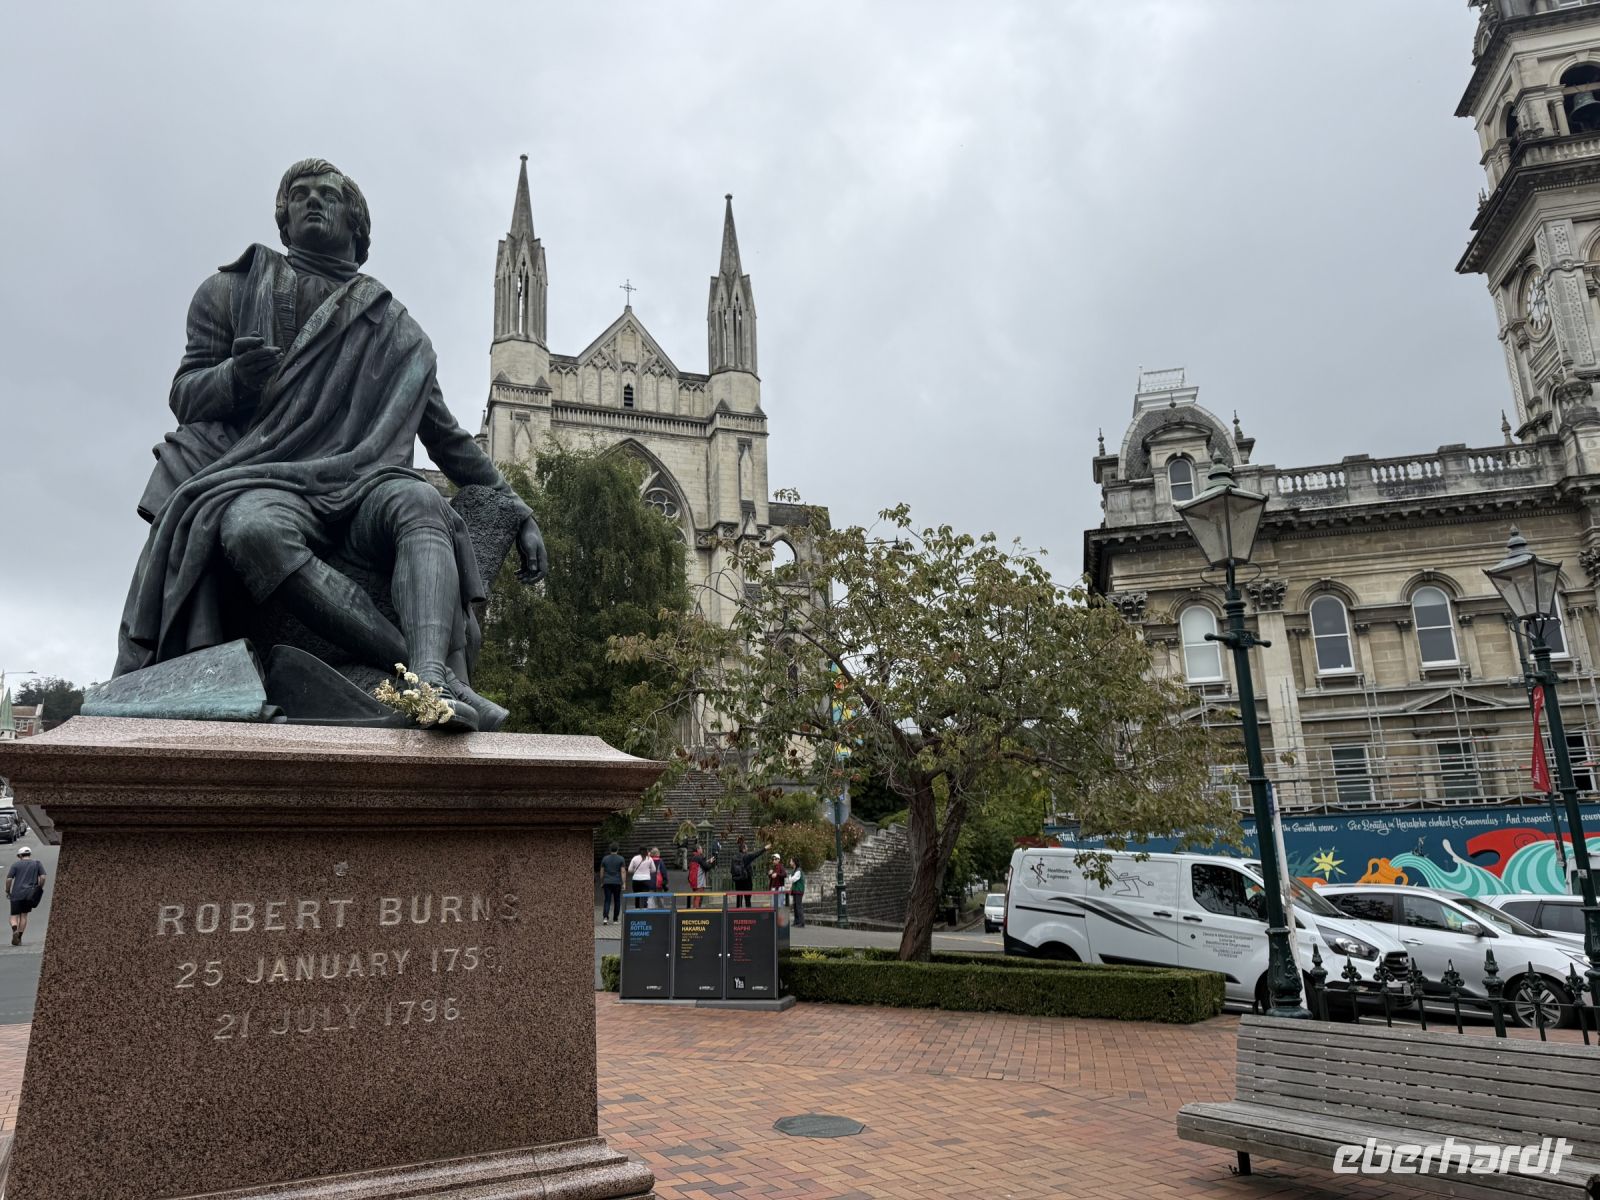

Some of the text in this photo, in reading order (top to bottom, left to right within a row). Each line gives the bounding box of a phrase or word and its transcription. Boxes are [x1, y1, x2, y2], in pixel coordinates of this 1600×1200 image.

[1291, 821, 1317, 832] Seventh
[1505, 813, 1521, 824] And
[157, 893, 519, 936] ROBERT BURNS
[174, 959, 223, 988] 25
[245, 948, 410, 984] JANUARY
[213, 1010, 250, 1040] 21
[270, 1002, 361, 1035] JULY
